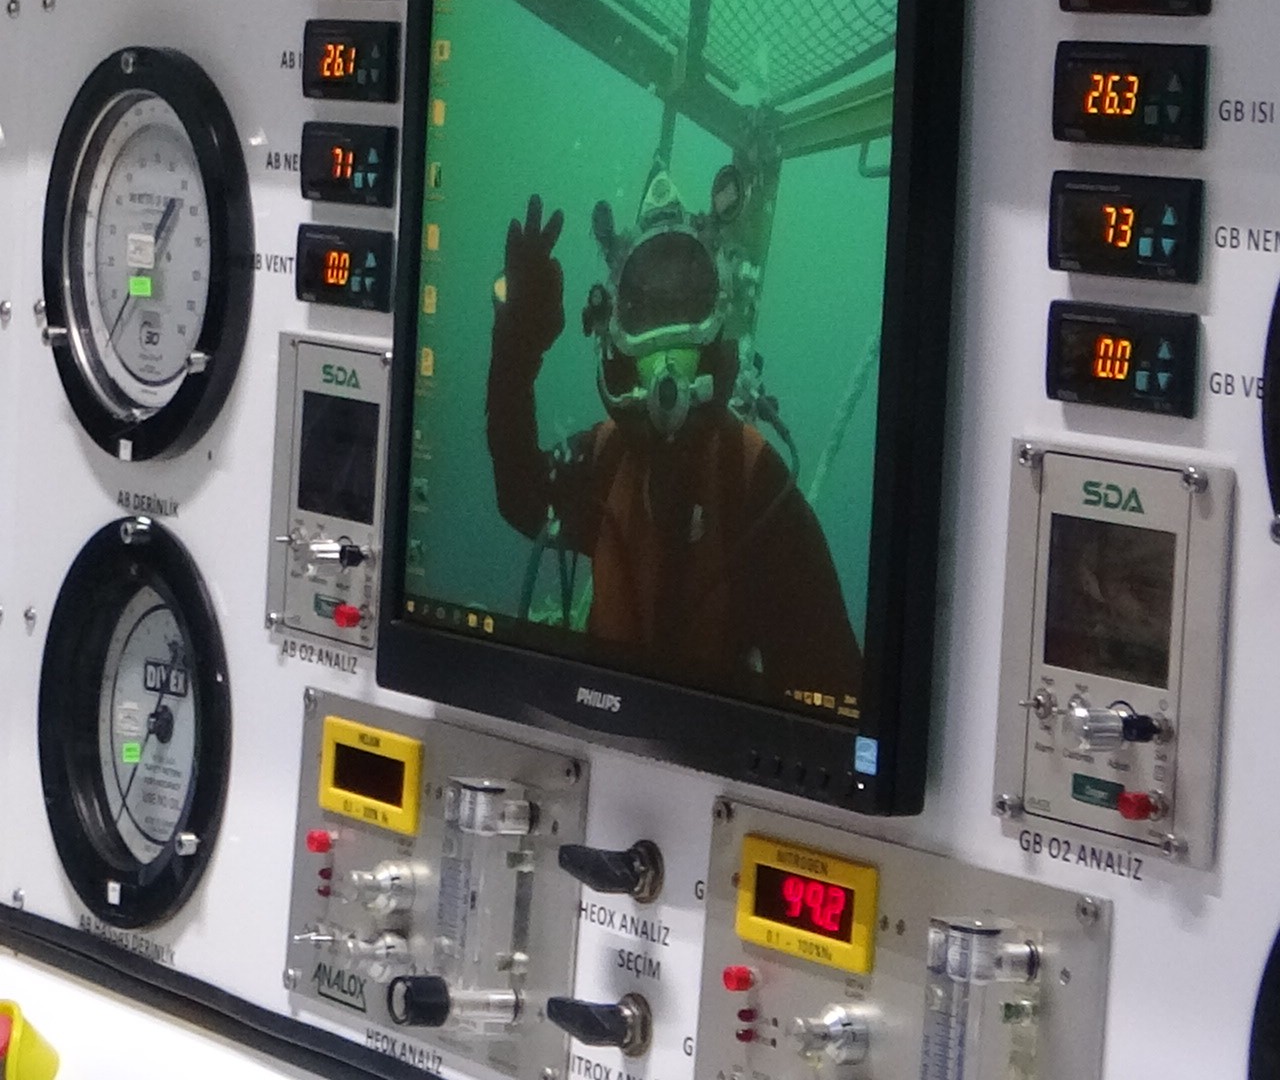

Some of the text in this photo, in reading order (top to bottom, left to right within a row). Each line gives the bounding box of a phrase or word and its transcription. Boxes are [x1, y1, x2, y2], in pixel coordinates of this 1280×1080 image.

[281, 51, 295, 69] AB
[1219, 100, 1274, 123] GB ISI
[266, 152, 281, 170] AB
[1103, 206, 1135, 248] 73
[1215, 226, 1240, 249] GB
[321, 364, 361, 389] SDA
[1210, 372, 1235, 395] GB
[1082, 480, 1145, 514] SDA
[281, 639, 297, 659] AB
[576, 686, 622, 713] PHILIPS
[1019, 830, 1043, 855] GB
[1076, 842, 1144, 881] ANALİZ
[580, 900, 670, 947] HEOX ANALİZ
[617, 948, 661, 981] SEÇİM
[312, 962, 367, 1000] ANALOX
[366, 1028, 398, 1058] HEOX
[683, 1037, 694, 1056] G
[572, 1055, 612, 1080] ITROX
